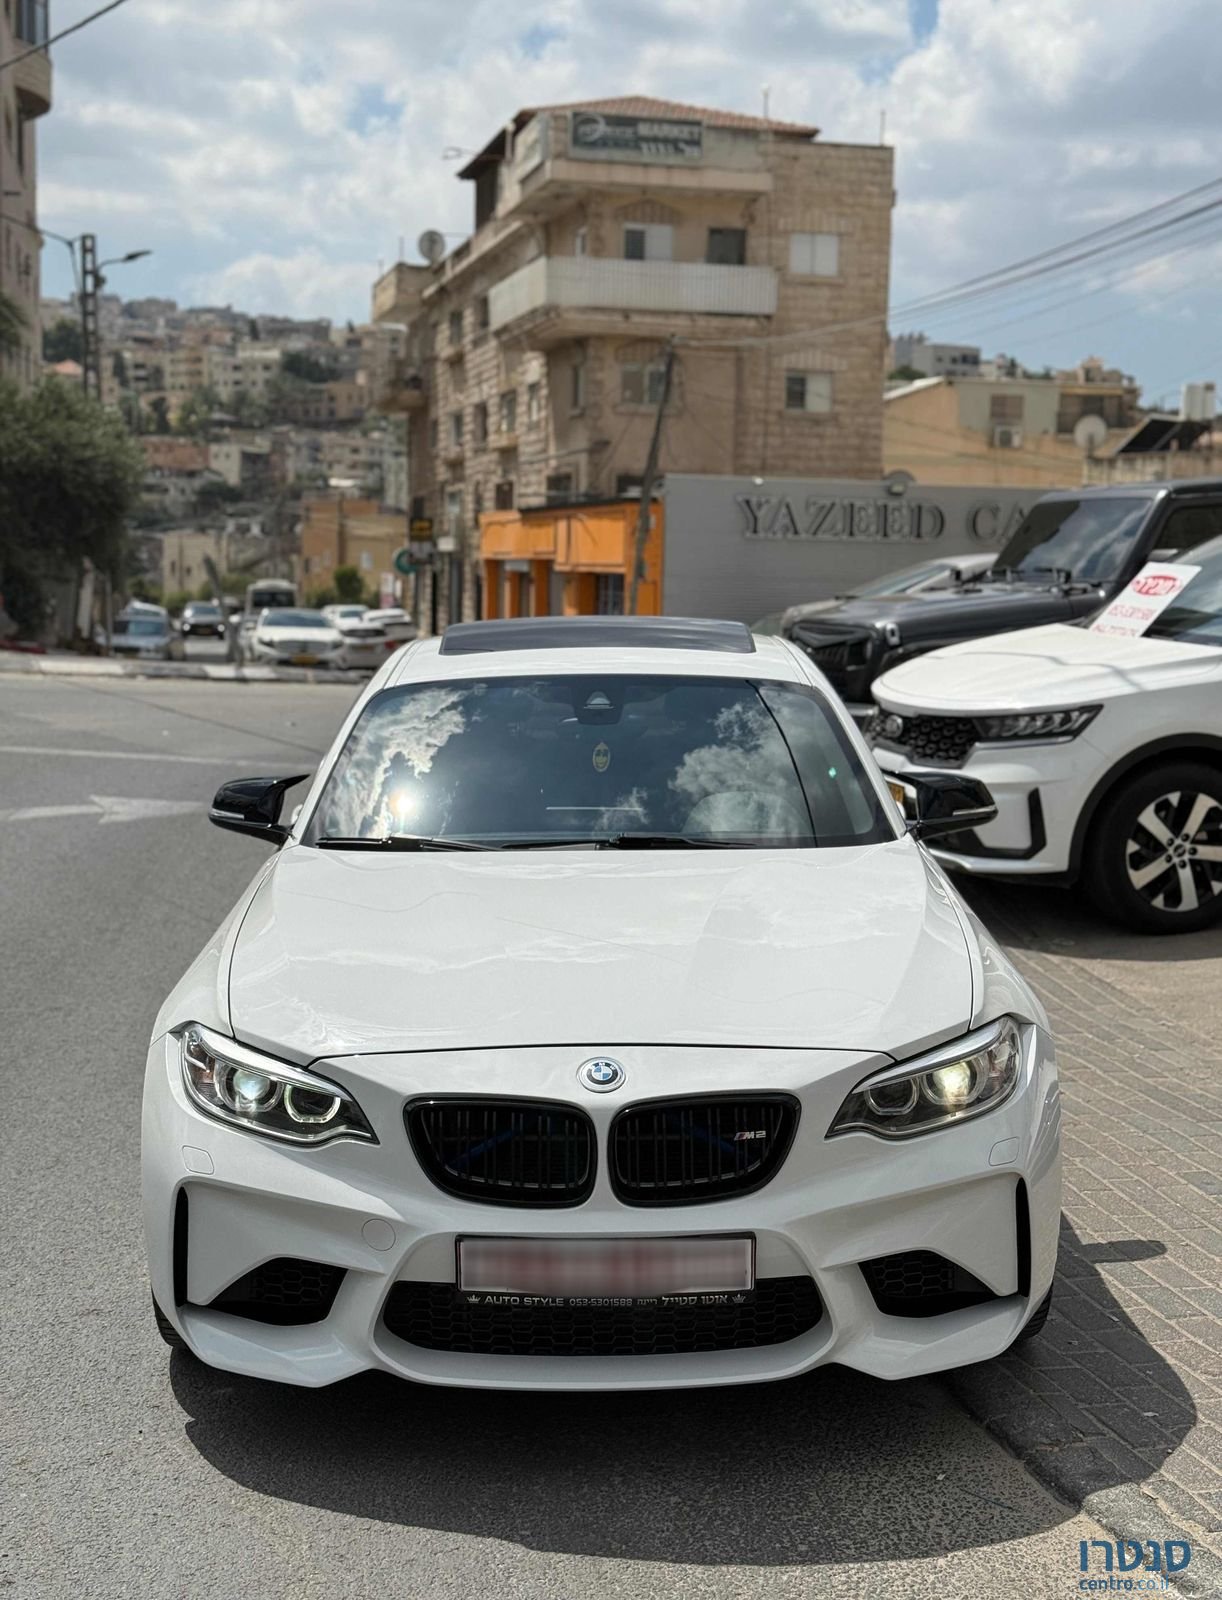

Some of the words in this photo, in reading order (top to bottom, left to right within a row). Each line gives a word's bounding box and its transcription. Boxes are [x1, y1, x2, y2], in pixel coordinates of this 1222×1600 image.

[737, 495, 946, 541] YAZEED
[484, 1295, 520, 1305] AUTO
[523, 1297, 564, 1306] STYLE
[701, 1294, 728, 1305] אוטו
